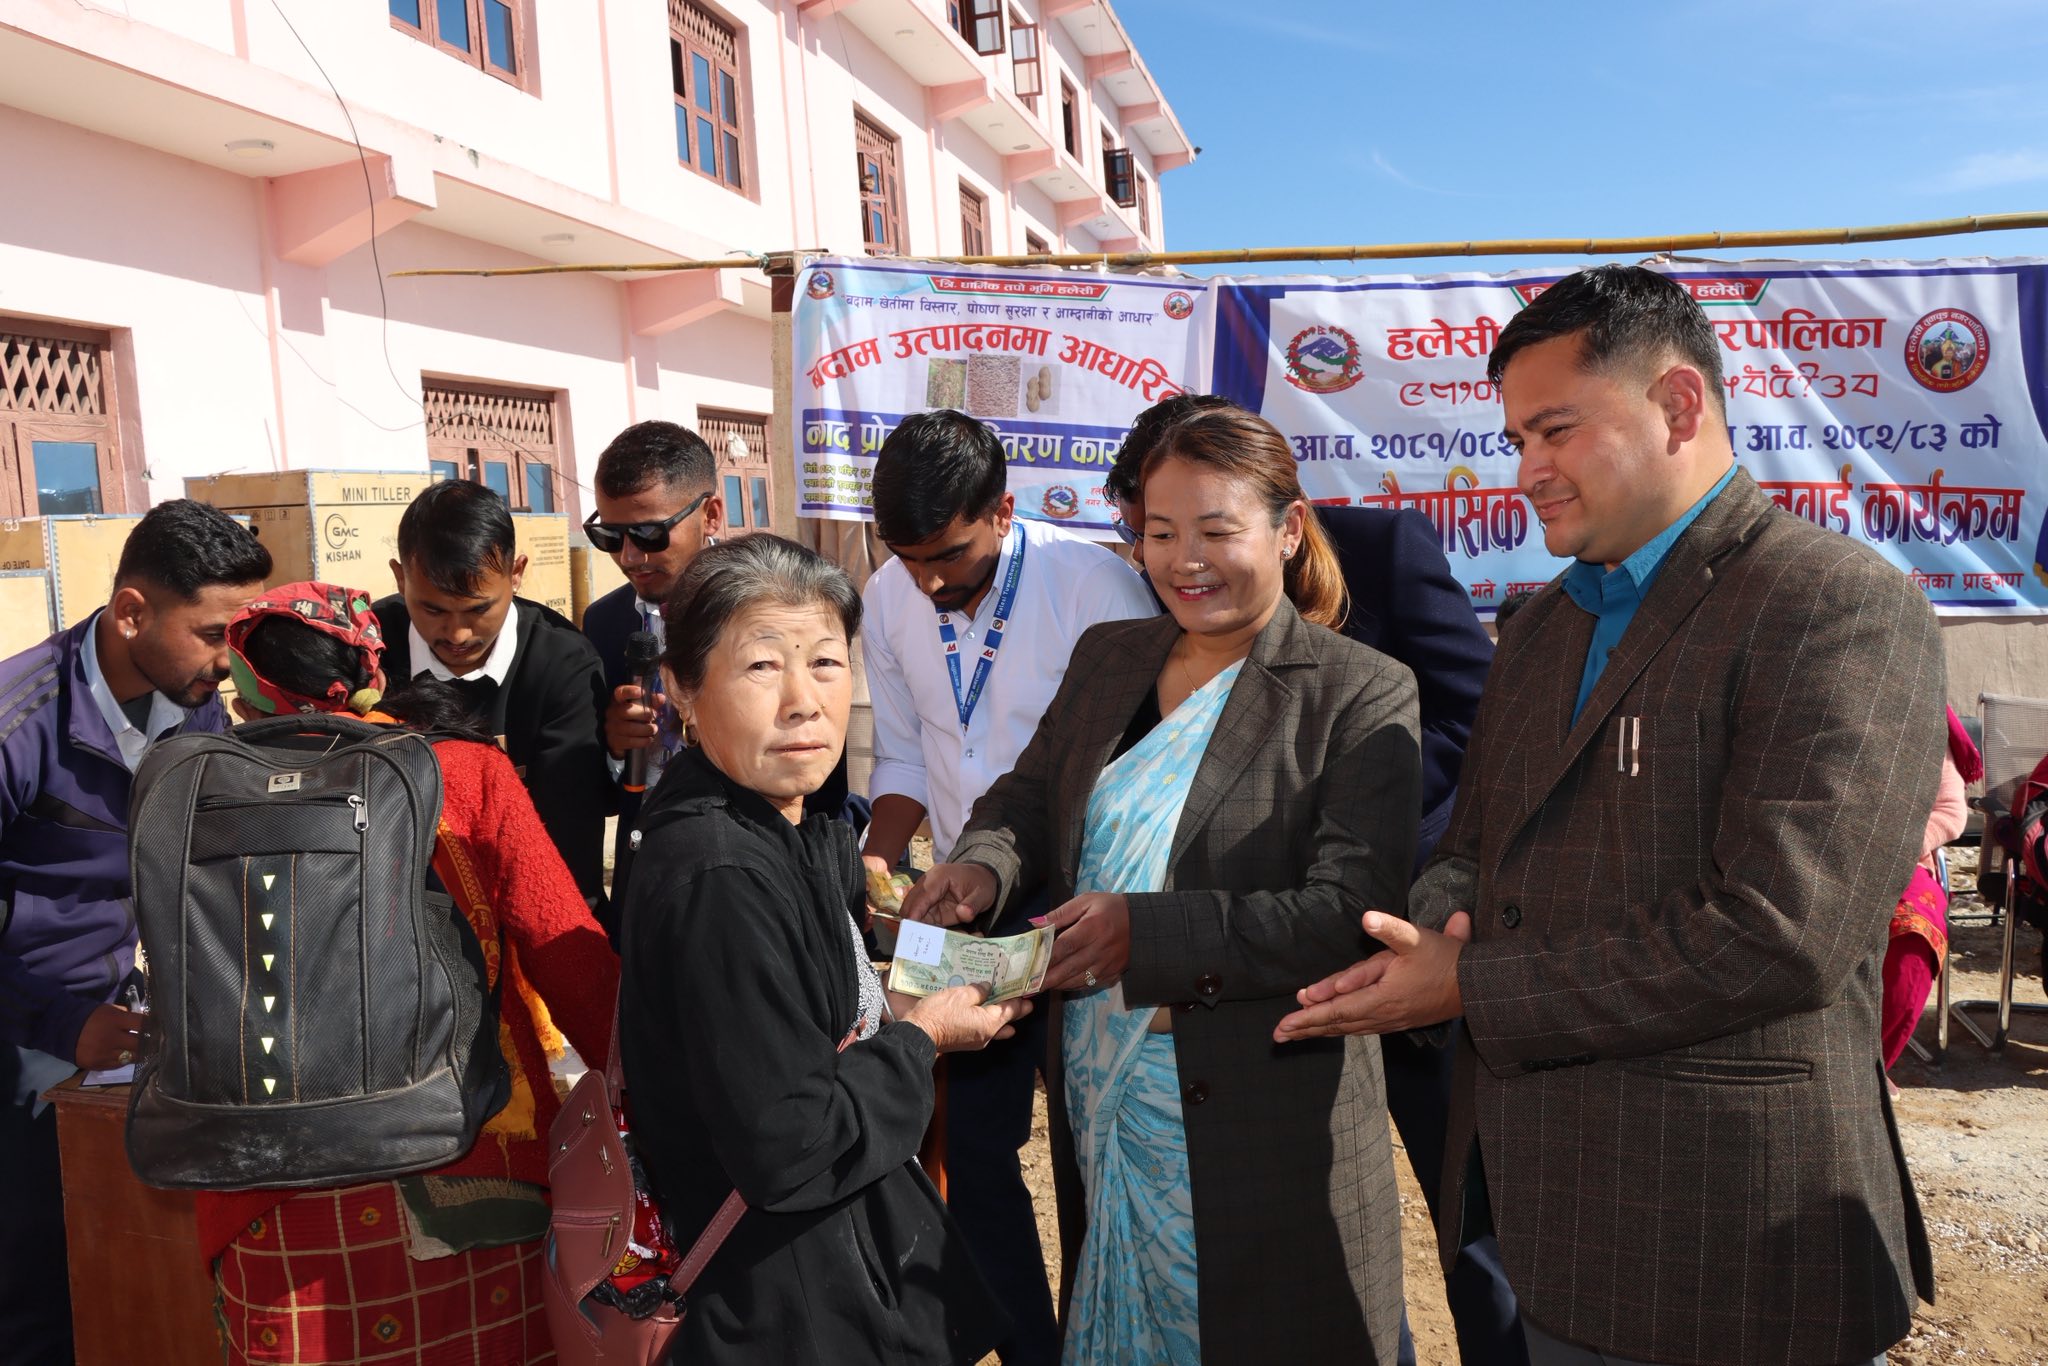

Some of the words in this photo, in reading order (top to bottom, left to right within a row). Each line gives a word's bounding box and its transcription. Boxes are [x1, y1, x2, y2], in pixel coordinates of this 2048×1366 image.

[880, 294, 915, 310] खेतीमा
[967, 300, 1000, 315] पोषण
[1005, 304, 1037, 321] सुरक्षा
[1042, 307, 1051, 320] र
[1711, 308, 1888, 352] रपालिका
[806, 337, 882, 390] बदाम
[889, 323, 1052, 359] उत्पादनमा
[1822, 420, 1949, 454] २०८२/८३
[1959, 414, 2004, 449] को
[342, 487, 368, 502] MINI
[371, 486, 411, 501] TILLER
[1861, 468, 2026, 545] कार्यक्रम
[332, 526, 359, 538] GMC
[326, 549, 362, 562] KISHAN
[1470, 578, 1496, 600] गते
